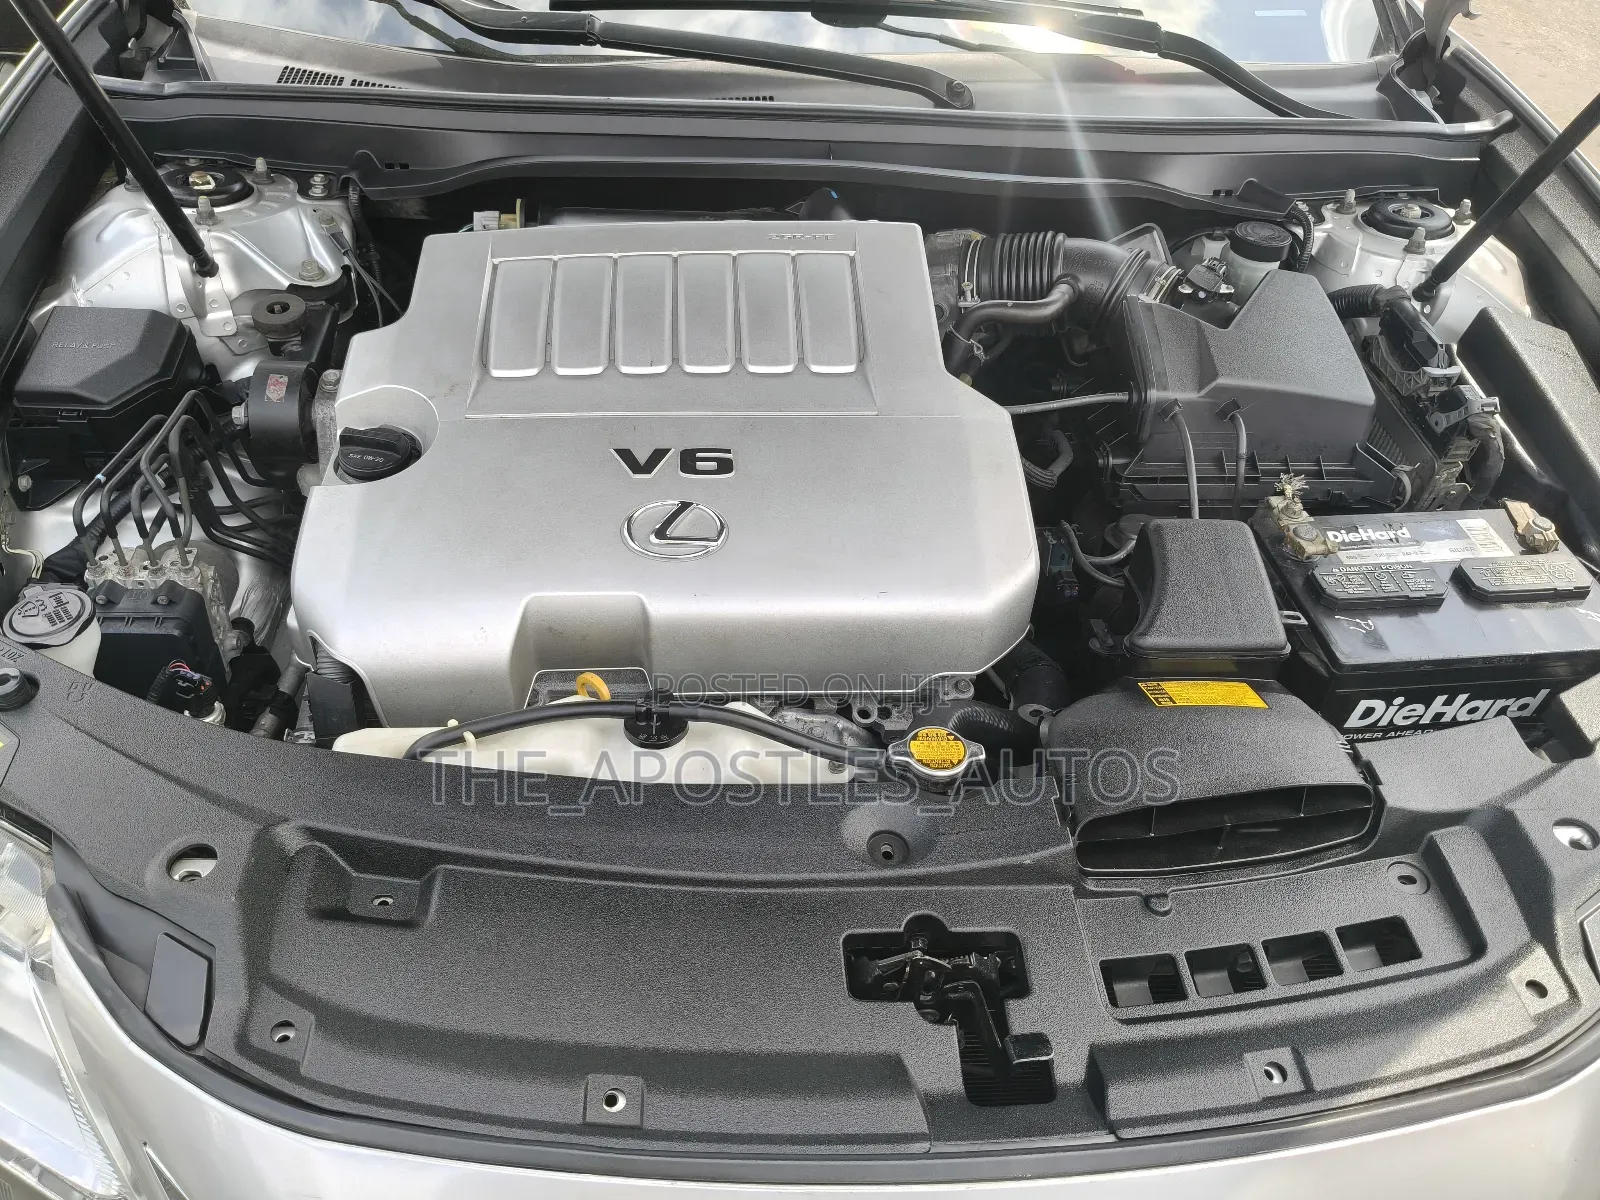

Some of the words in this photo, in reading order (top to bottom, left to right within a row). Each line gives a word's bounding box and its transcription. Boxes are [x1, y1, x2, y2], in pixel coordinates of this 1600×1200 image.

[609, 447, 735, 478] V6
[1326, 526, 1412, 543] DieHard
[1343, 688, 1551, 728] DieHard
[1341, 732, 1383, 740] OWER
